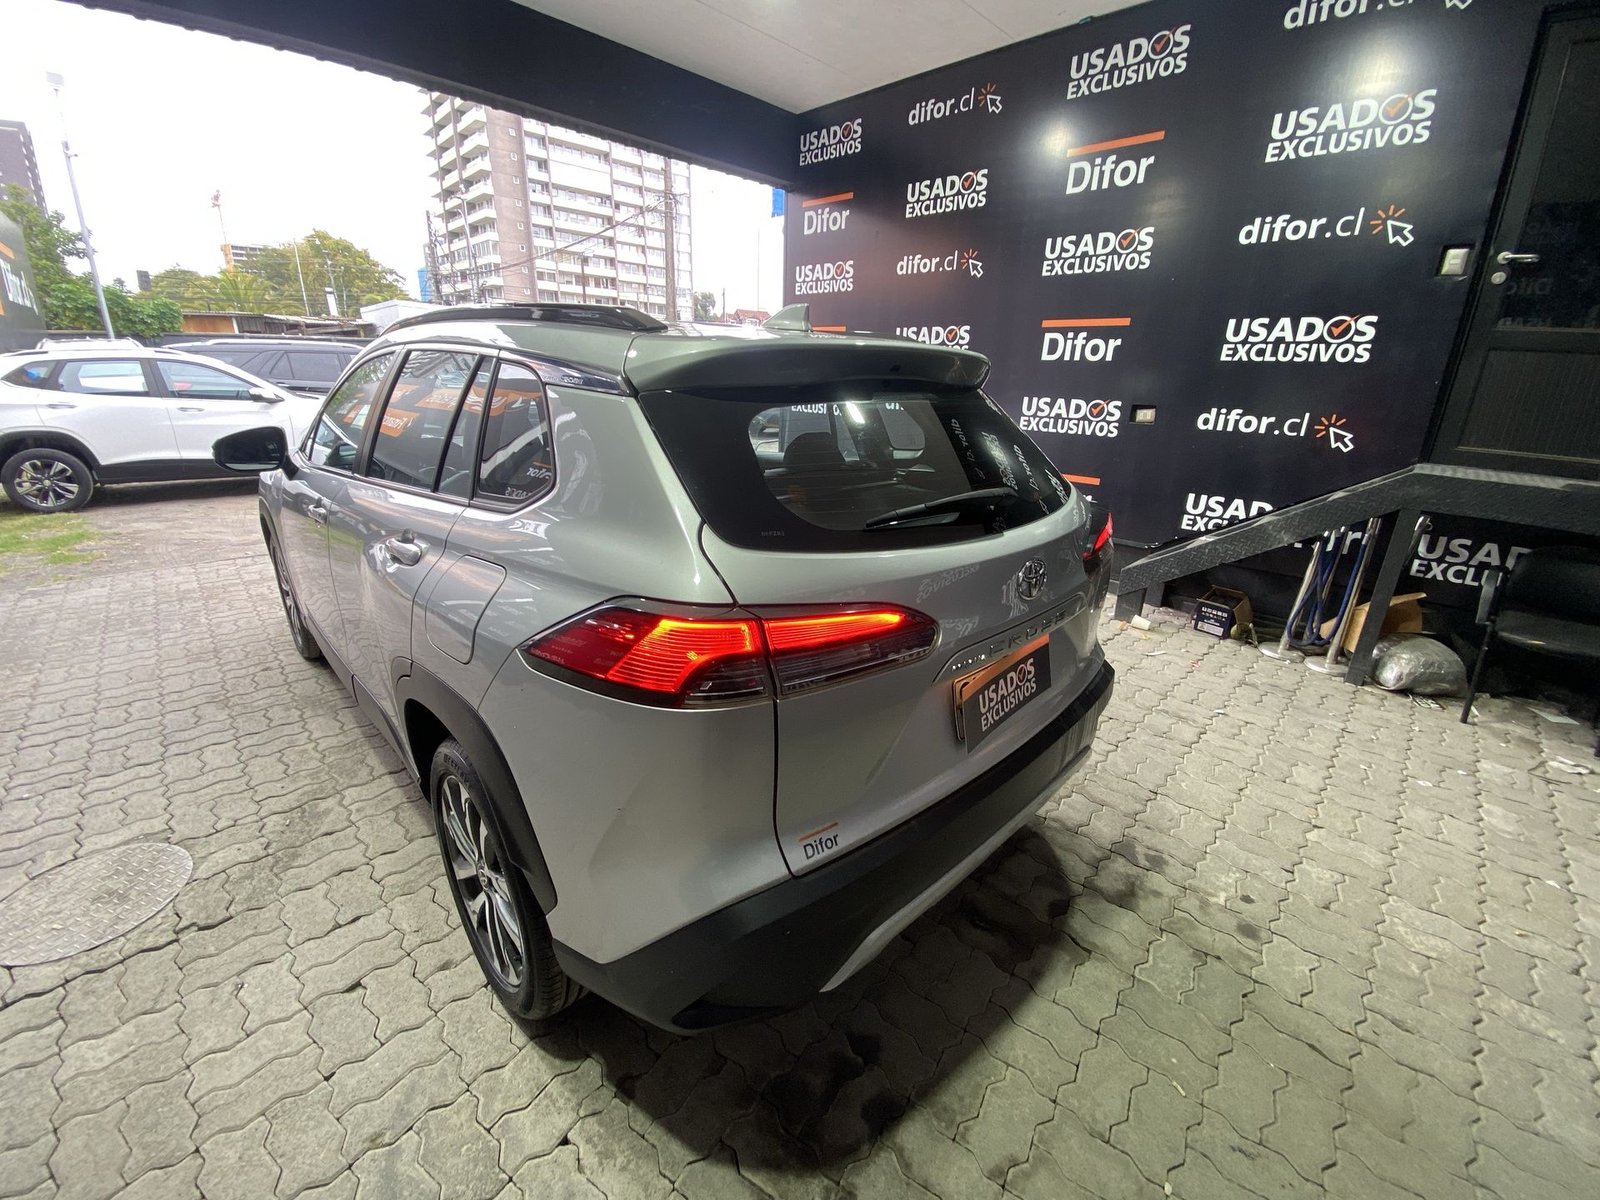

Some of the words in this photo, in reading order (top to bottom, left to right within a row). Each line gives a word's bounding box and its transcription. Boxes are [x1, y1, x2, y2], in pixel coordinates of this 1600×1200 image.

[1070, 24, 1191, 79] USADOS
[1067, 53, 1188, 100] EXCLUSIVOS
[908, 87, 975, 125] difor.cl
[1271, 88, 1437, 140] USADOS
[800, 118, 862, 152] USADOS
[1264, 120, 1432, 163] EXCLUSIVOS
[799, 138, 862, 166] EXCLUSIVOS
[907, 168, 988, 202] USADOS
[1065, 155, 1155, 195] Difor
[905, 191, 987, 218] EXCLUSIVOS
[803, 207, 850, 235] Difor
[1238, 207, 1365, 245] difor.cl
[1044, 227, 1155, 258] USADOS
[795, 260, 854, 283] USADOS
[897, 250, 958, 275] difor.cl
[1041, 251, 1151, 276] EXCLUSIVOS
[795, 278, 854, 296] EXCLUSIVOS
[1225, 315, 1378, 343] USADOS
[1041, 331, 1122, 362] Difor
[1219, 343, 1372, 363] EXCLUSIVOS
[1021, 396, 1122, 423] USADOS
[1197, 408, 1310, 436] difor.cl
[1019, 417, 1119, 438] EXCLUSIVOS
[979, 658, 1035, 714] USADOS
[981, 677, 1037, 732] EXCLUSIVOS
[803, 832, 839, 860] Difor
